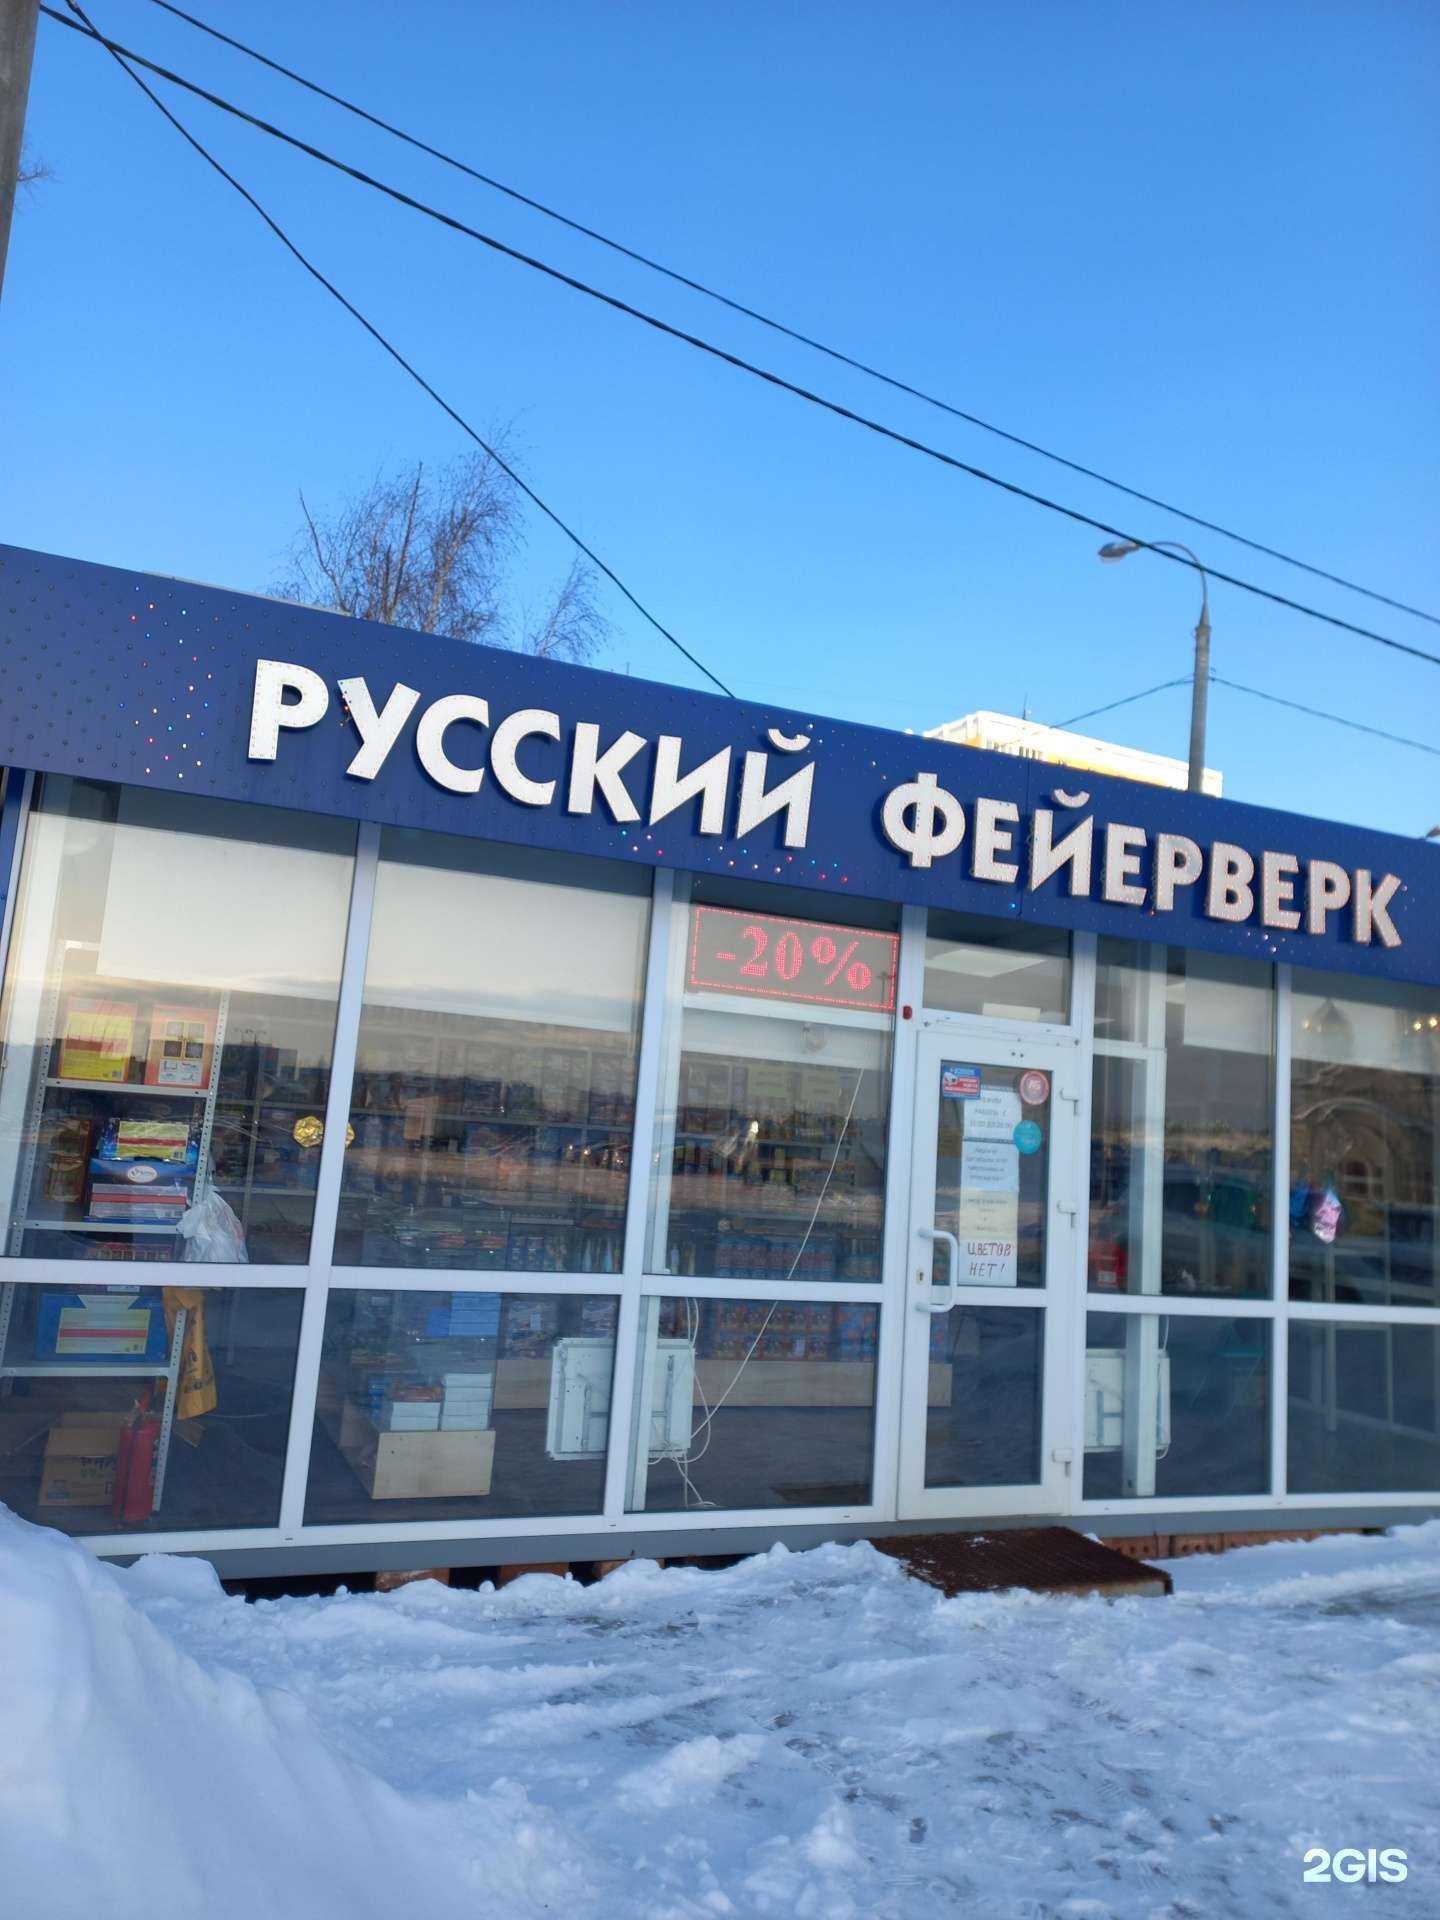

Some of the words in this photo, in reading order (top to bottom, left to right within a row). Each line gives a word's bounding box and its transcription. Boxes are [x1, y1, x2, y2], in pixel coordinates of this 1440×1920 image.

[248, 659, 815, 847] РУССКИЙ
[882, 772, 1402, 948] ФЕЙЕРВЕРК
[715, 926, 873, 990] -20%
[967, 1242, 1011, 1256] ЦВЕТОВ
